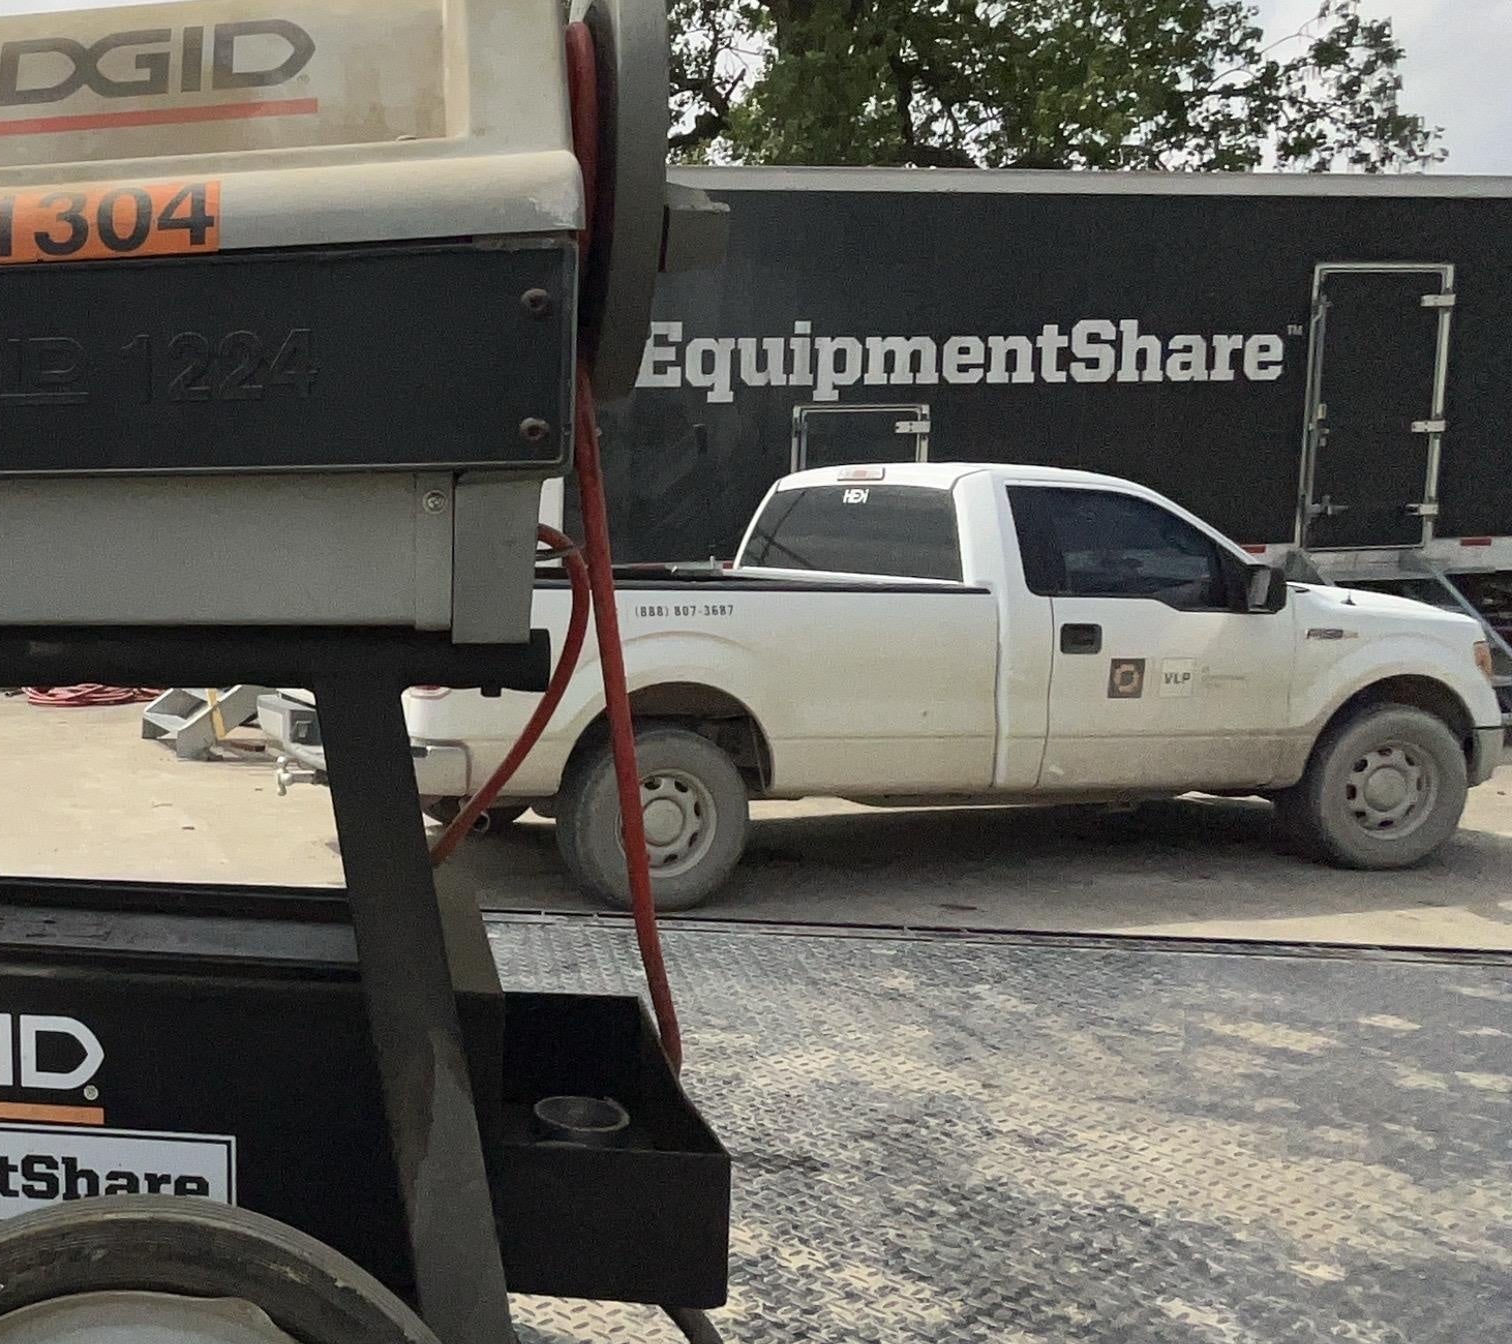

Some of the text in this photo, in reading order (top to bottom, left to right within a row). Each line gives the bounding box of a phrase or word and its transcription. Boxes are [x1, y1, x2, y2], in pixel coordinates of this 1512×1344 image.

[119, 327, 319, 404] 1224
[635, 319, 1285, 404] EquipmentShare
[635, 605, 669, 617] (888)
[1164, 672, 1191, 684] VLP
